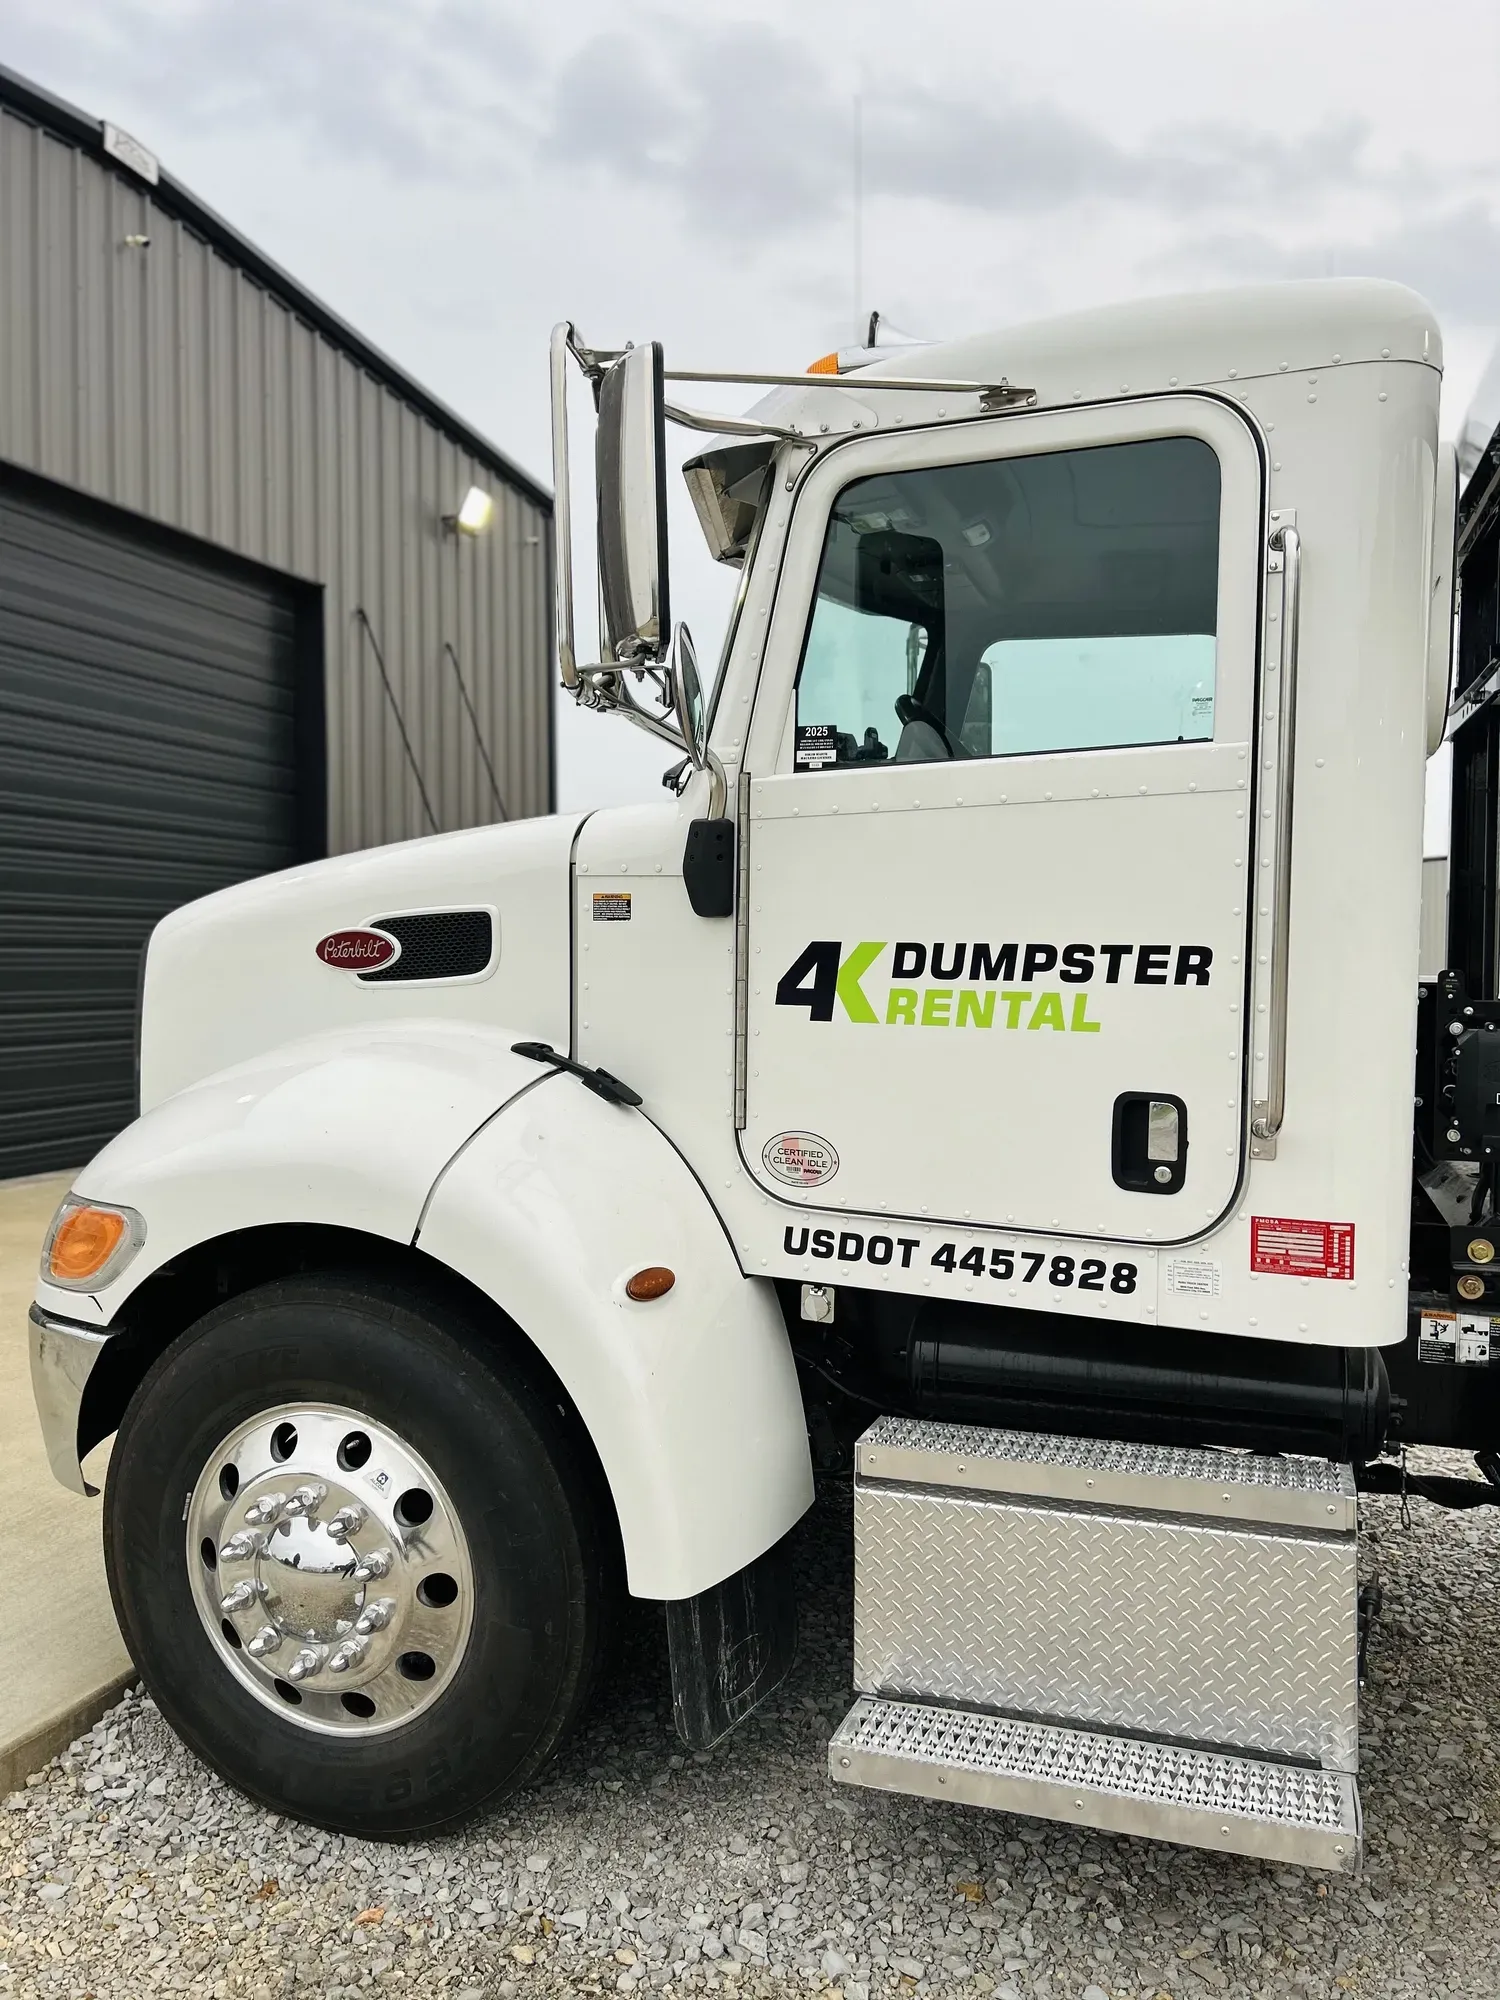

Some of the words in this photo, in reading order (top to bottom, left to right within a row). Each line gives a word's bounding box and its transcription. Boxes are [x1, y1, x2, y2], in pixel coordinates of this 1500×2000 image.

[805, 726, 828, 737] 2025
[324, 938, 386, 960] Peterbilt
[775, 941, 888, 1022] 4K
[891, 942, 1214, 986] DUMPSTER
[885, 988, 1101, 1033] RENTAL
[772, 1156, 804, 1166] CLEAN
[807, 1160, 828, 1168] IDLE
[777, 1147, 824, 1159] CERTIFIED
[783, 1226, 921, 1269] USDOT
[930, 1243, 1138, 1295] 4457828
